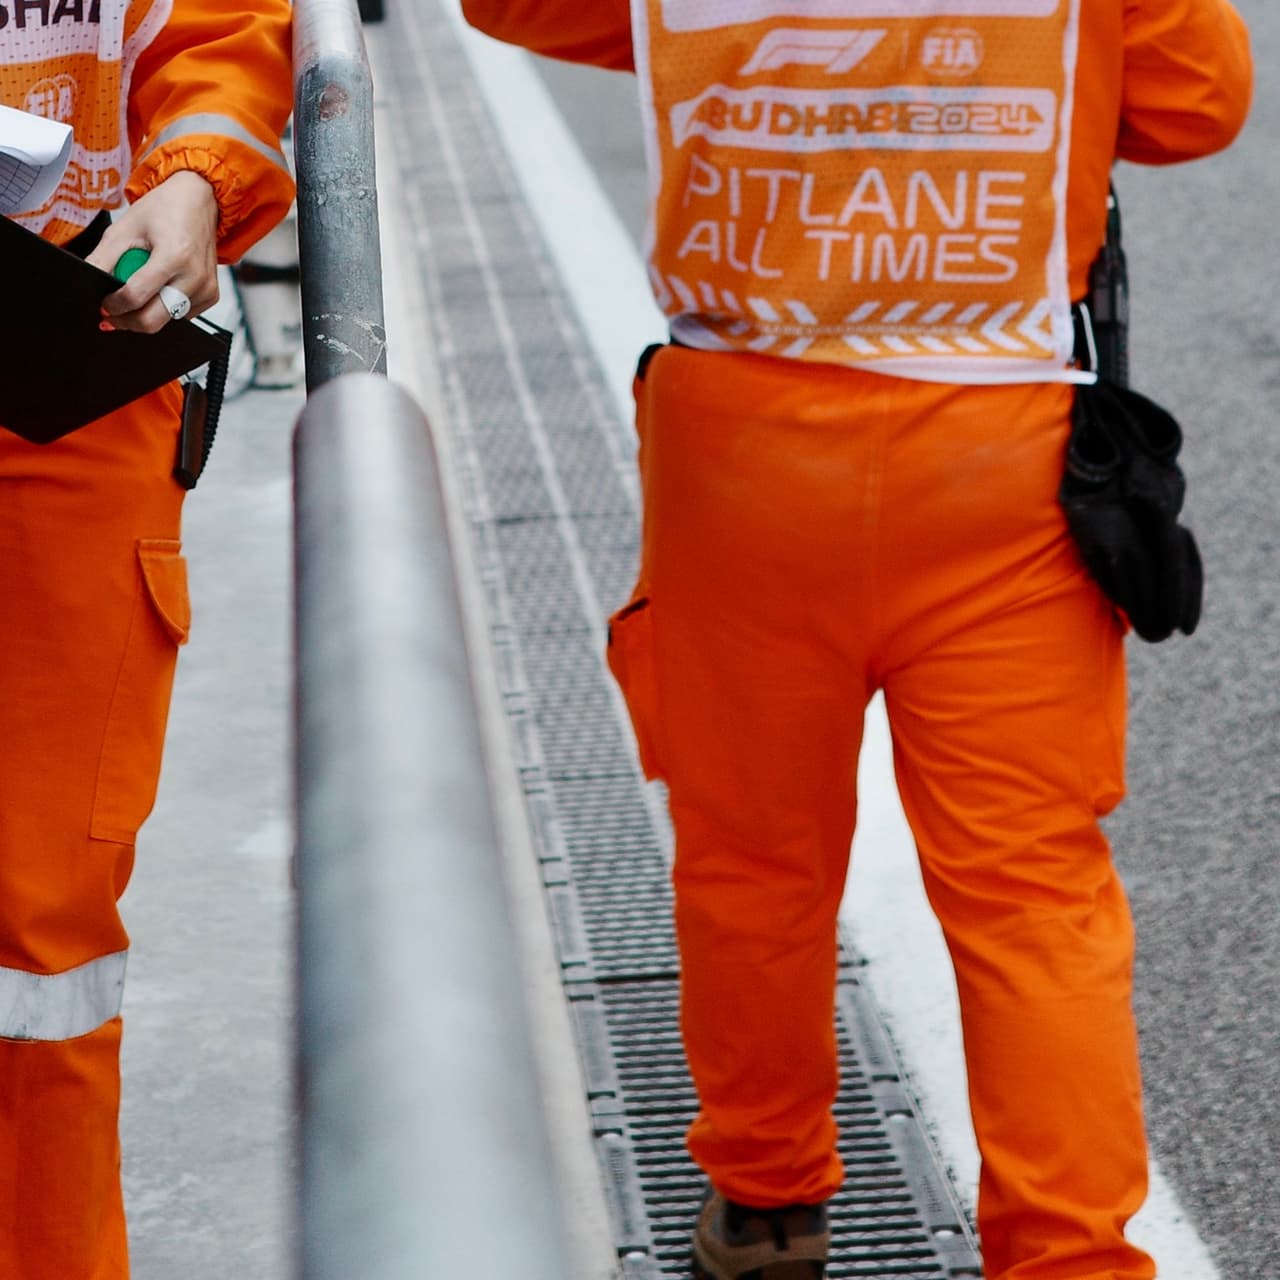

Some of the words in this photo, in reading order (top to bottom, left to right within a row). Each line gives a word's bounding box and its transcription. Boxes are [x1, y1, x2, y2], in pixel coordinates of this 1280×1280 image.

[922, 36, 982, 67] FIA
[907, 102, 1030, 136] 2024
[677, 220, 784, 279] ALL
[804, 229, 1020, 284] TIMES
